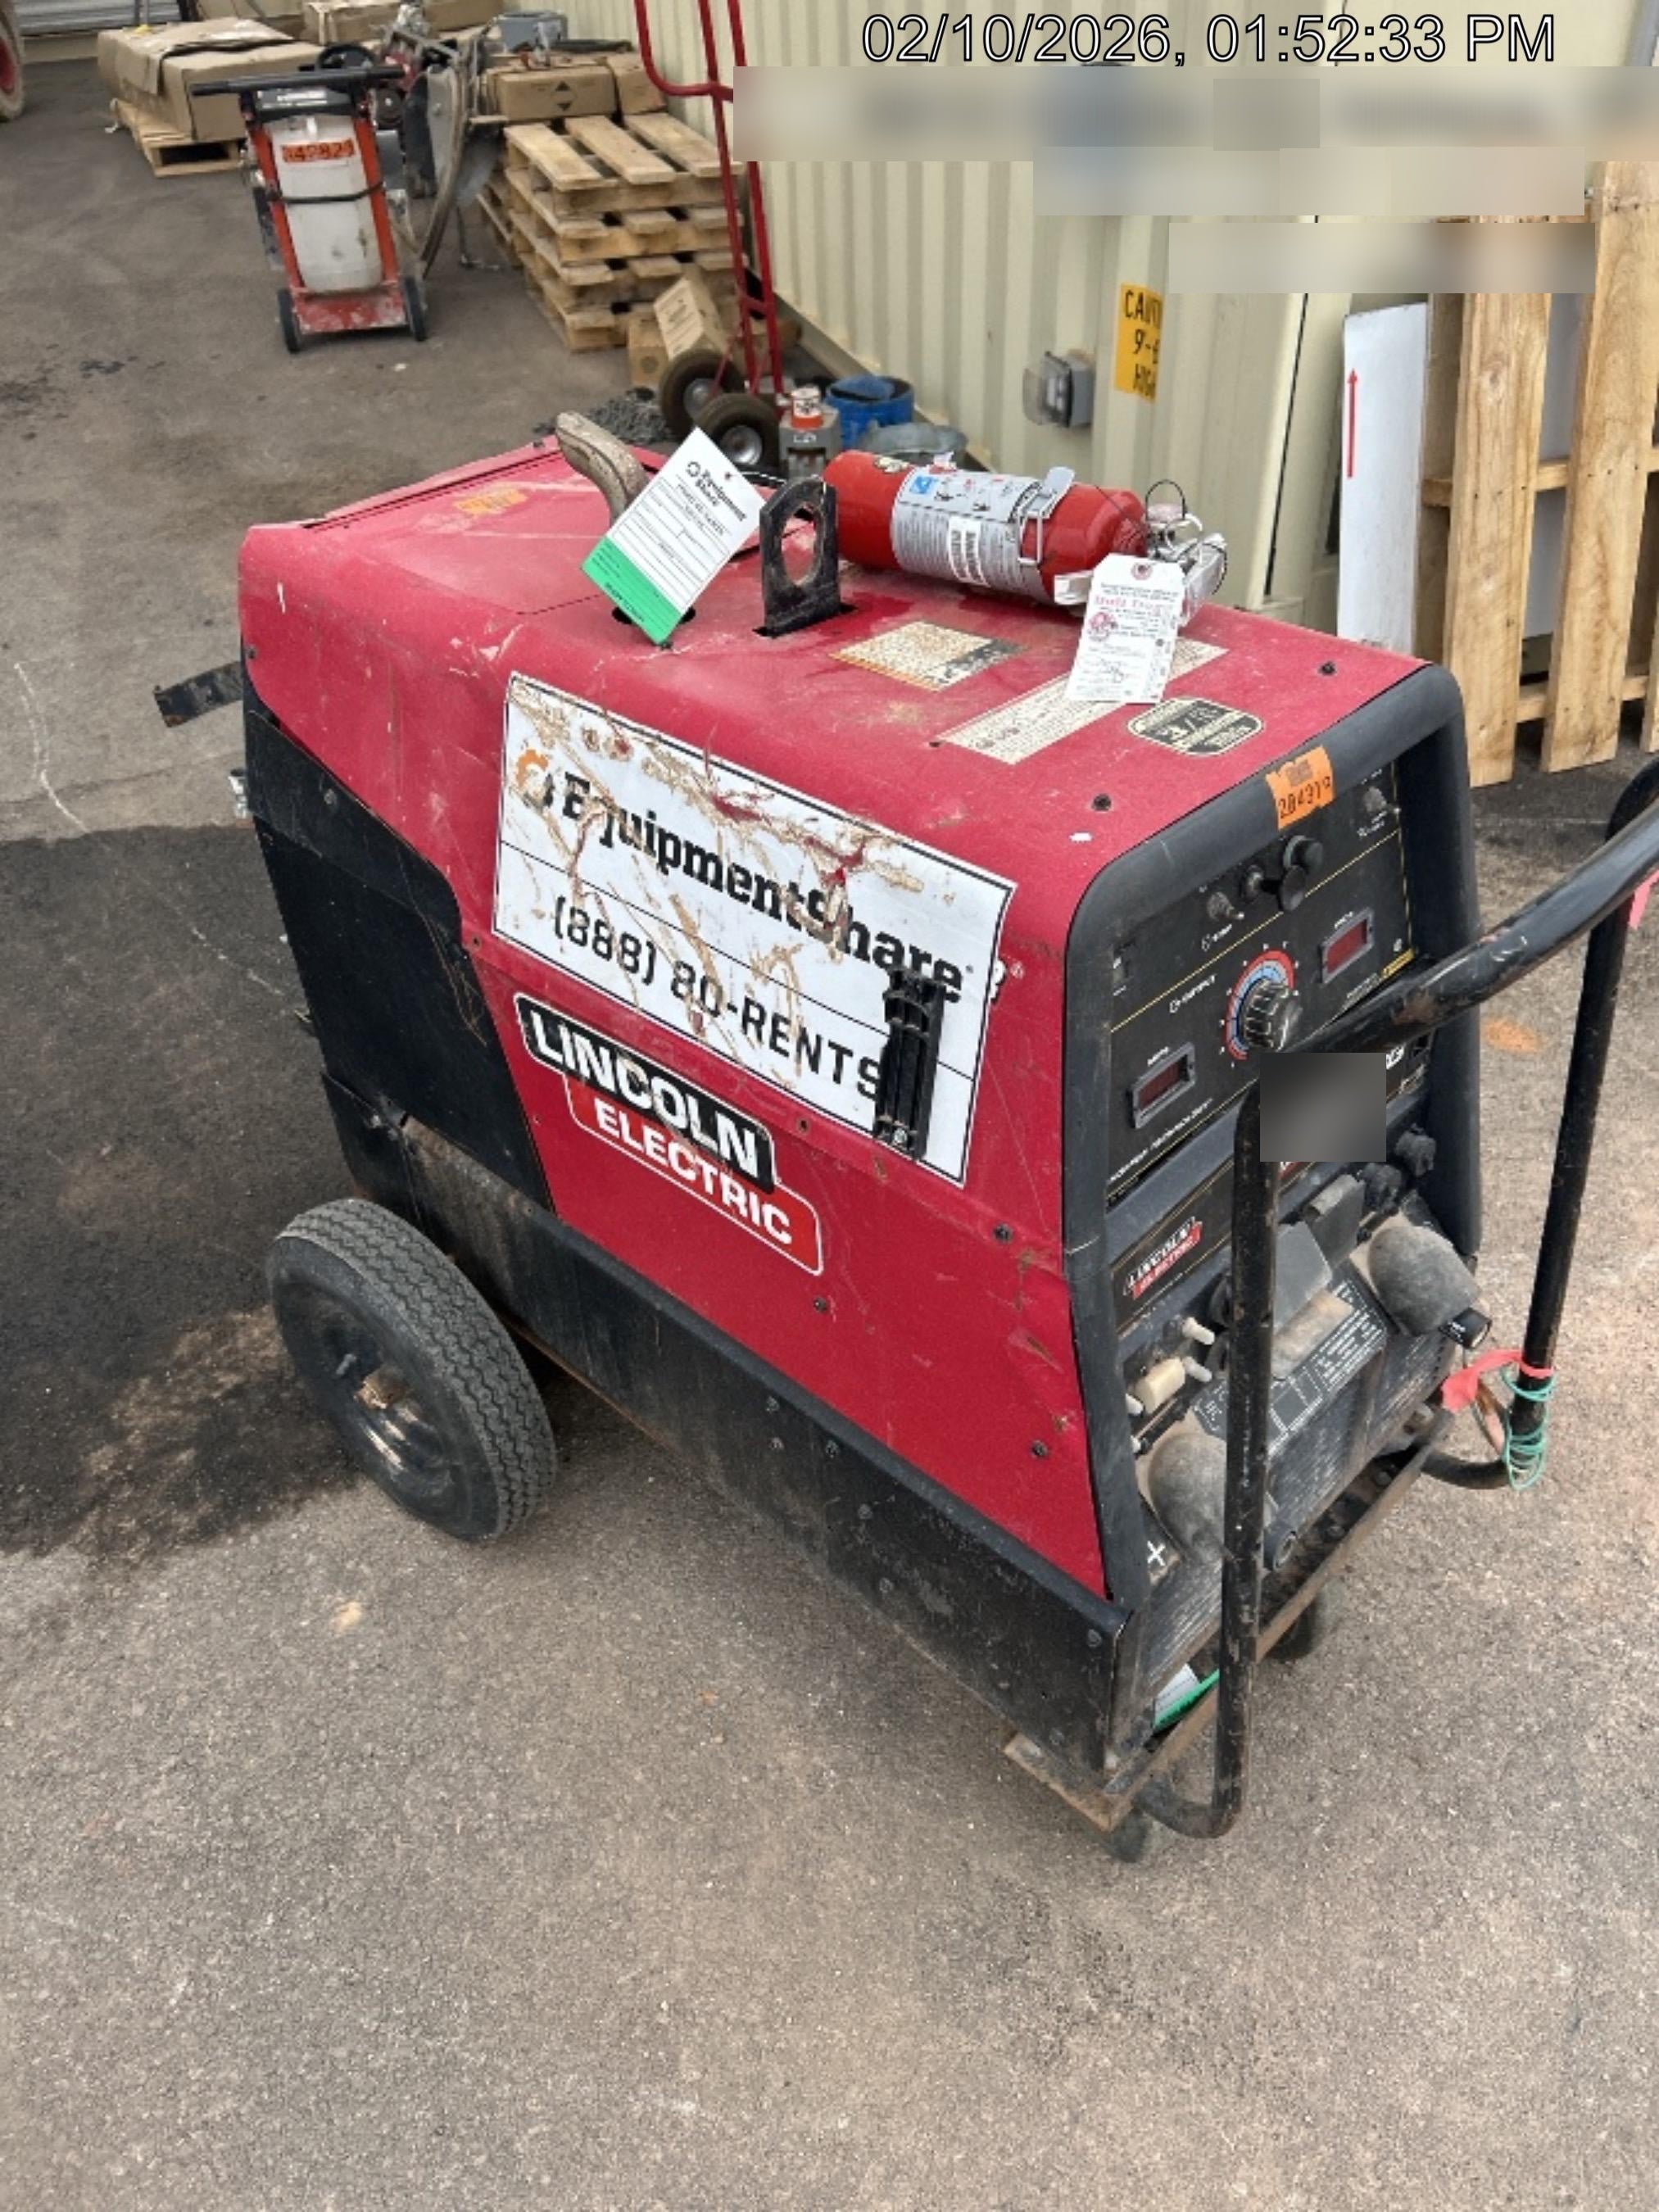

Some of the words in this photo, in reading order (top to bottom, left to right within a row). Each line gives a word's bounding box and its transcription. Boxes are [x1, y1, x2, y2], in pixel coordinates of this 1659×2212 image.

[555, 895, 656, 987] (888)
[531, 1009, 759, 1179] LINCOLN
[670, 960, 882, 1101] 80-RENTS
[594, 1098, 792, 1245] ELECTRIC
